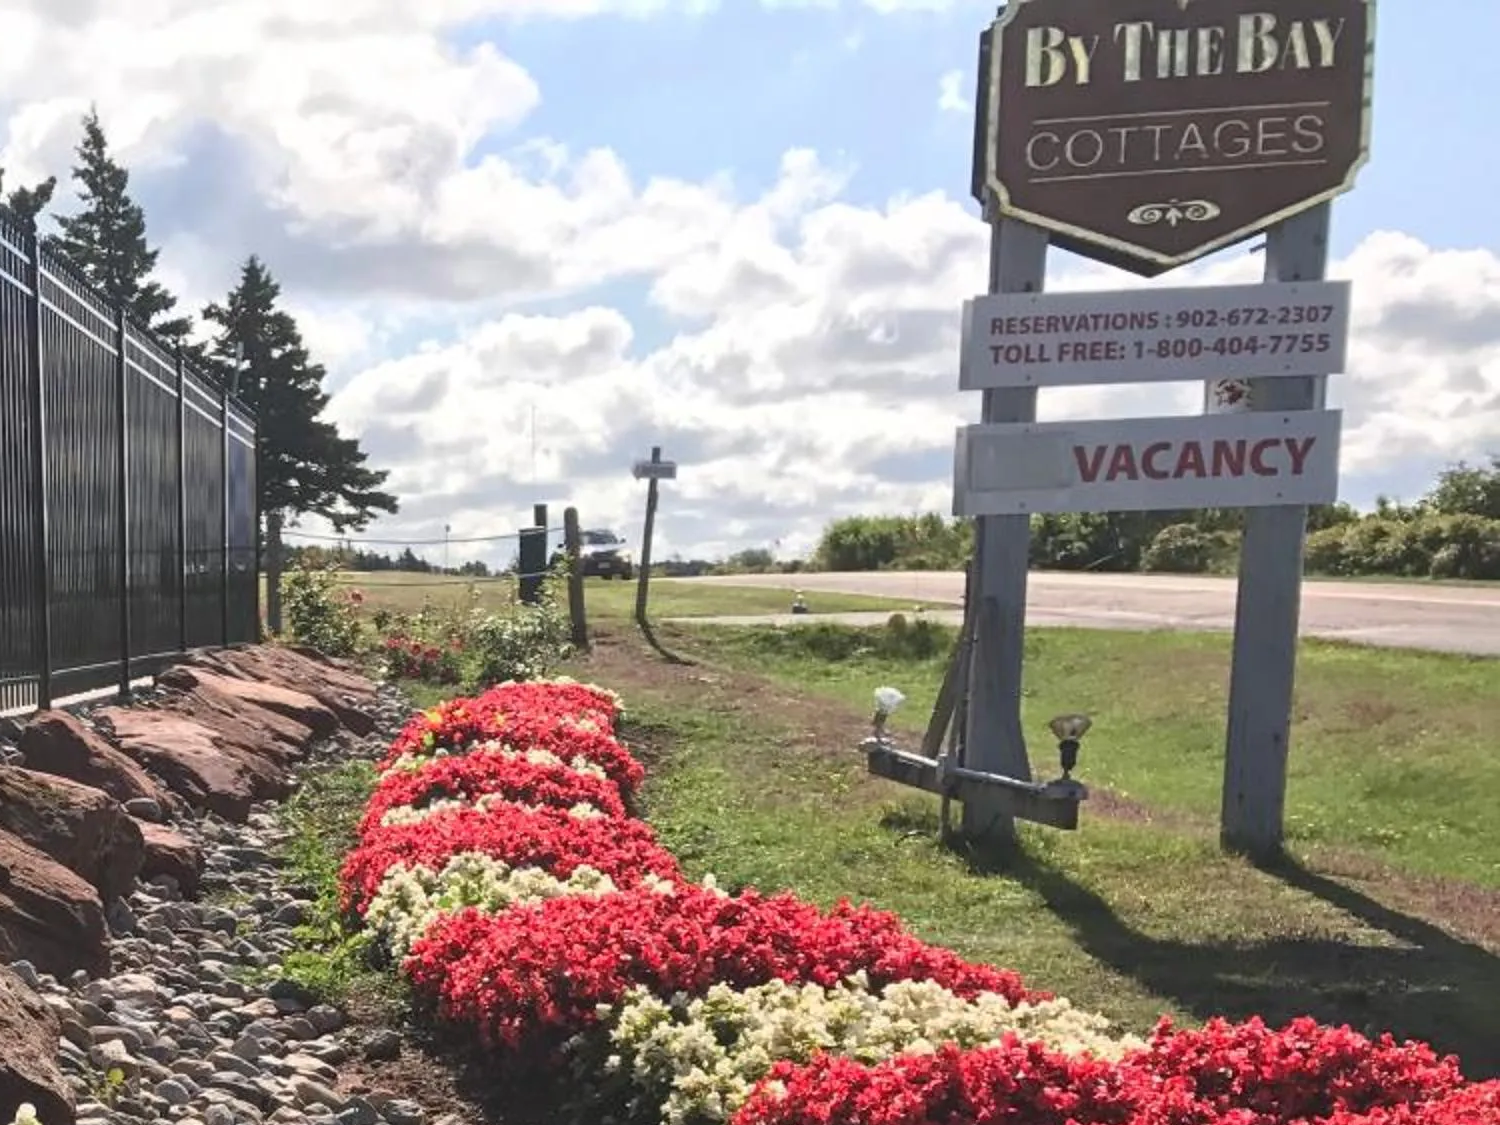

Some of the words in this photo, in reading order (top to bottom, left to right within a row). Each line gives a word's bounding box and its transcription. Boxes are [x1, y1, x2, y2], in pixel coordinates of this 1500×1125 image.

[1025, 26, 1099, 87] BY
[1113, 21, 1225, 82] THE
[1236, 12, 1345, 73] BAY
[1025, 115, 1324, 170] COTTAGES
[1176, 305, 1333, 328] 902-672-2307
[989, 343, 1051, 365] TOLL
[1057, 341, 1125, 362] FREE:
[1134, 333, 1331, 361] 1-800-404-7755
[1073, 437, 1317, 483] VACANCY
